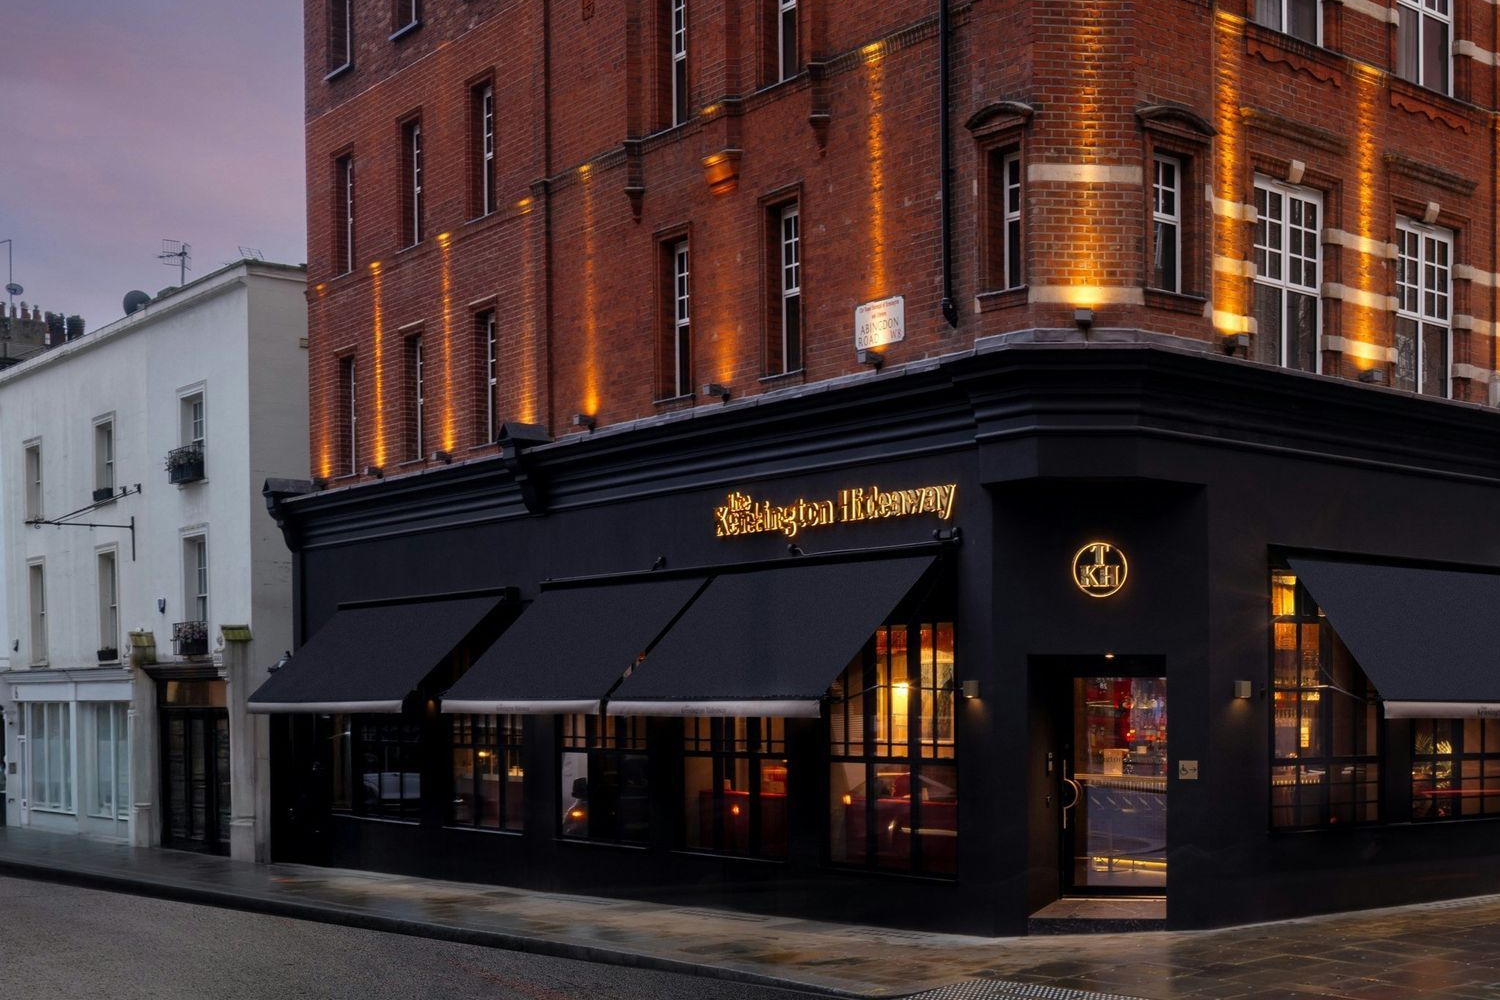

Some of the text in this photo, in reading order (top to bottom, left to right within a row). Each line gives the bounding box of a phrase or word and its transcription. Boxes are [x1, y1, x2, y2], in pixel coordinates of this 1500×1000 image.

[860, 317, 899, 335] ABINGDON
[858, 333, 880, 347] ROAD
[715, 484, 957, 538] Kensington Hideaway
